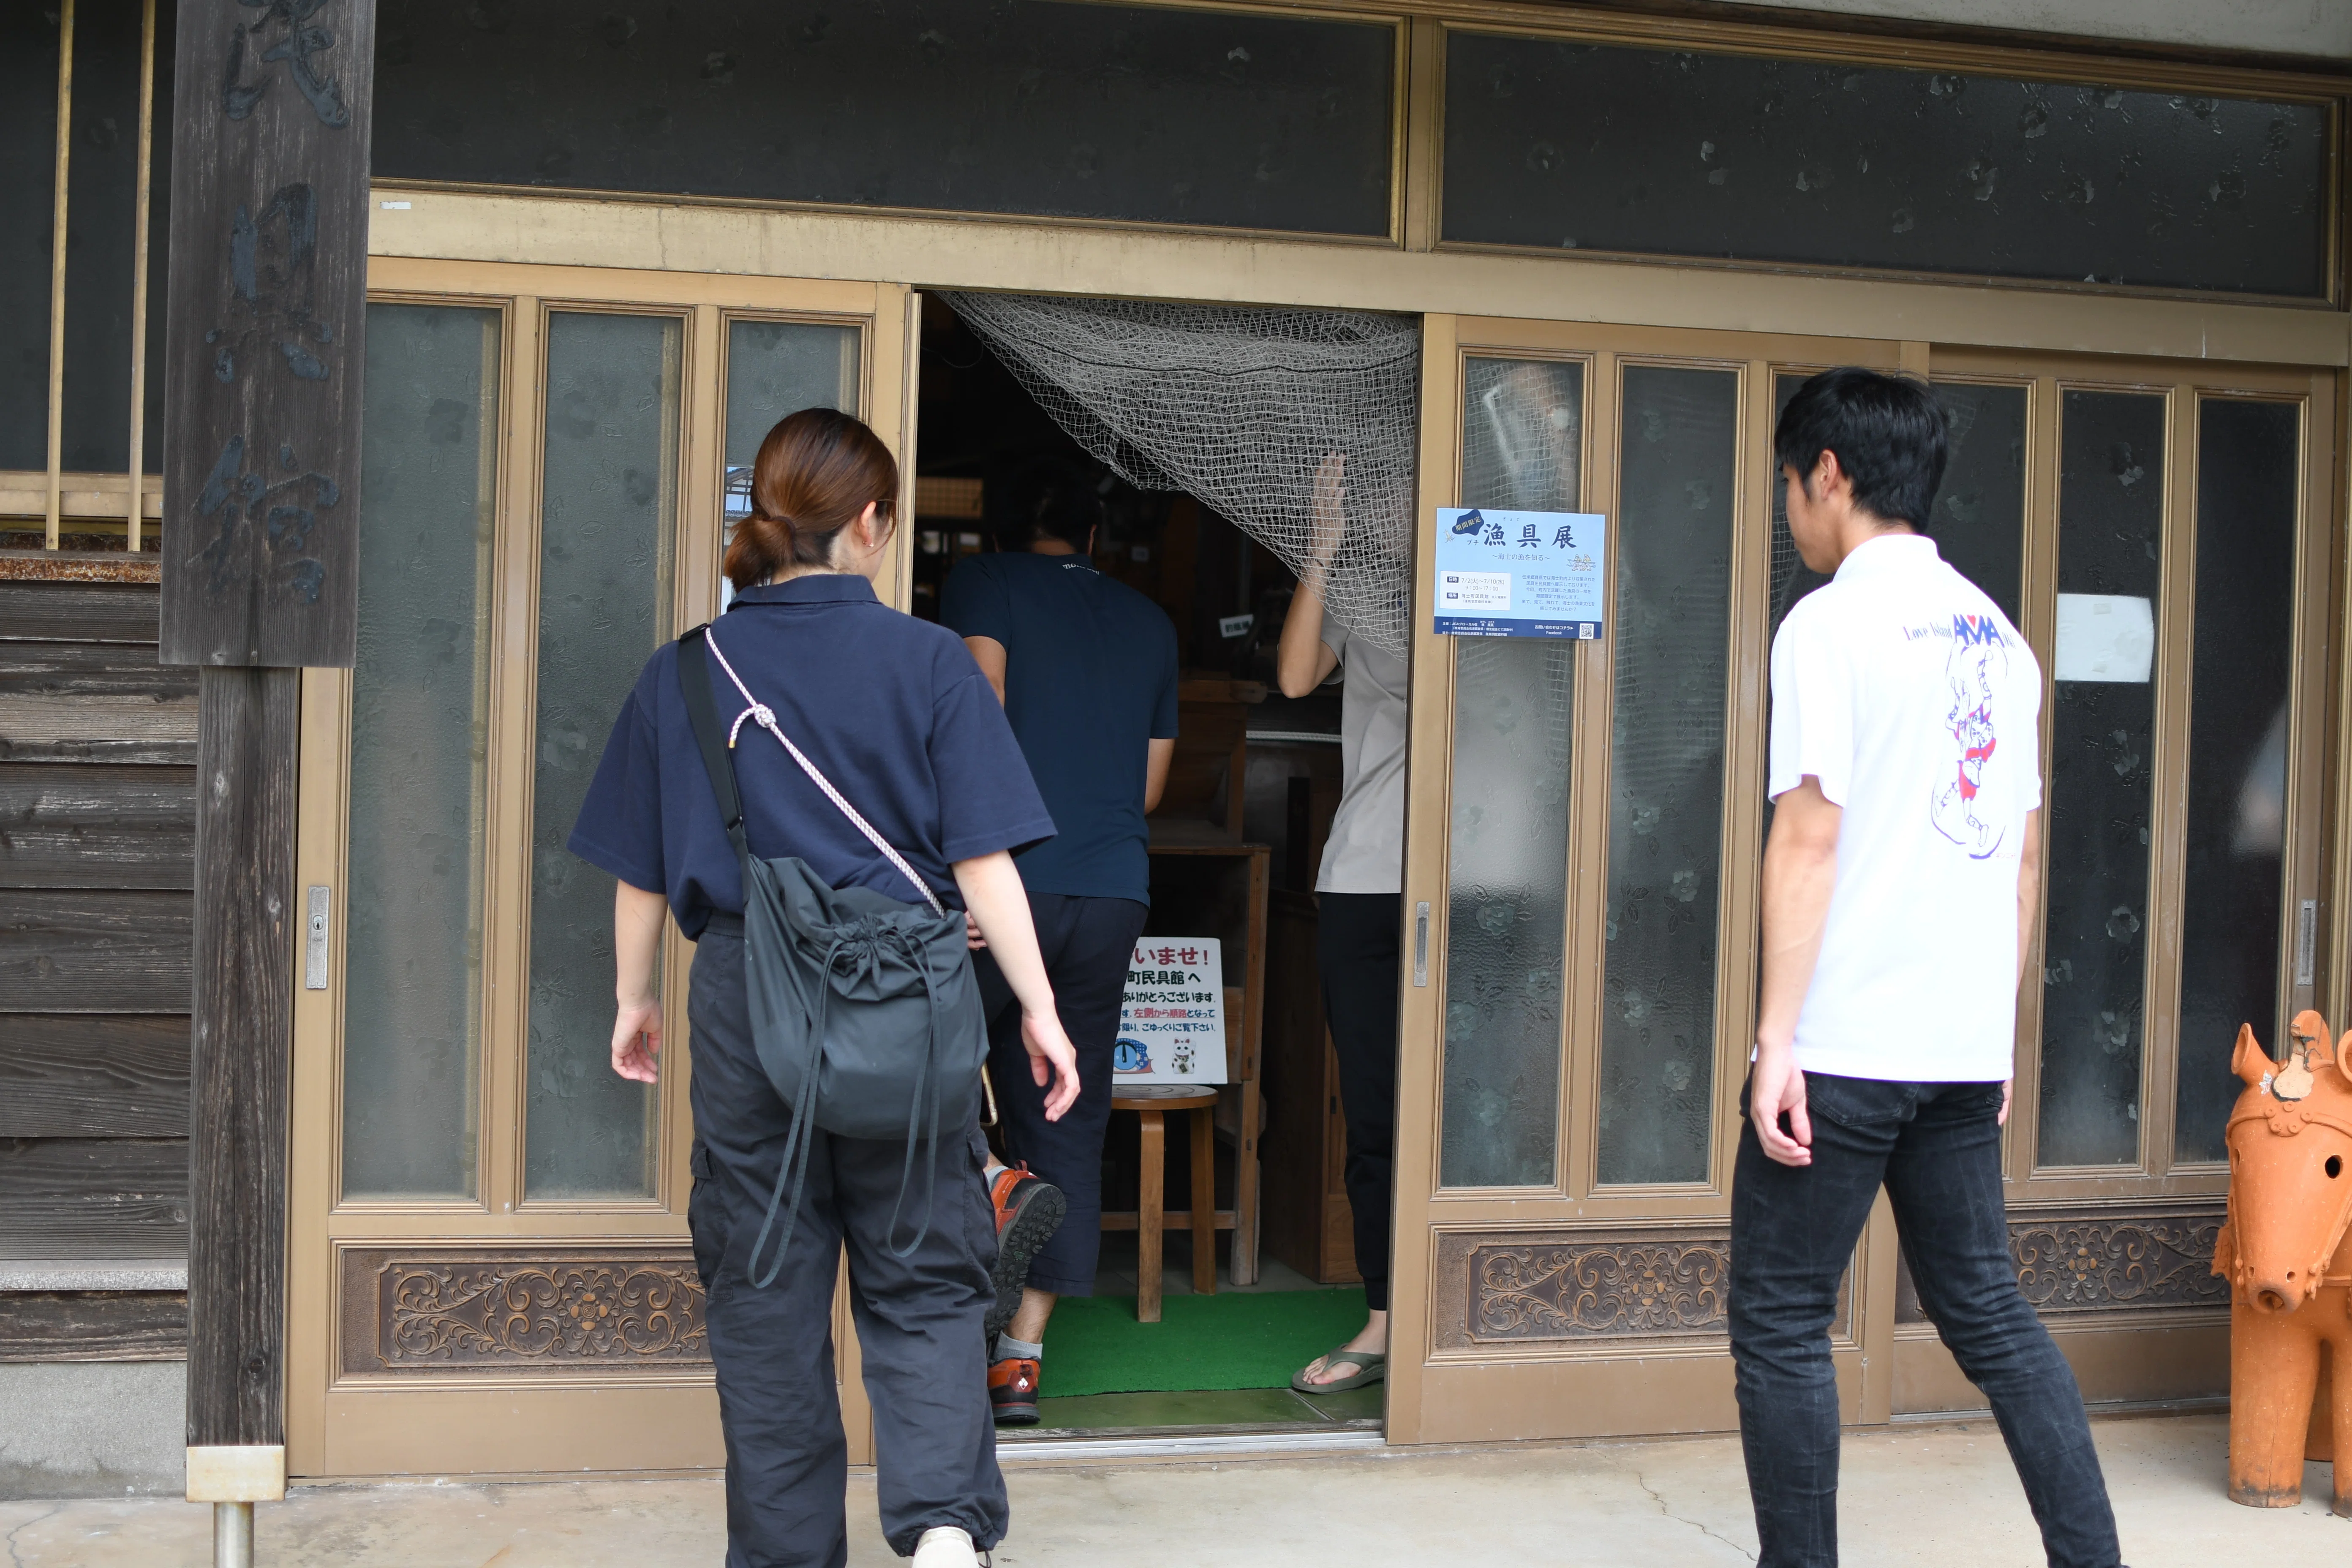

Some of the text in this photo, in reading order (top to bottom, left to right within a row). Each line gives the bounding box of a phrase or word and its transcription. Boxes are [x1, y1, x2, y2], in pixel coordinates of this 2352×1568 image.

[1455, 516, 1481, 531] 期間限定
[1484, 523, 1577, 549] 漁具展
[1903, 626, 1929, 641] Love
[1929, 621, 1953, 639] Island
[1131, 946, 1208, 965] いませ！
[1122, 991, 1216, 1003] ありがとうございます。
